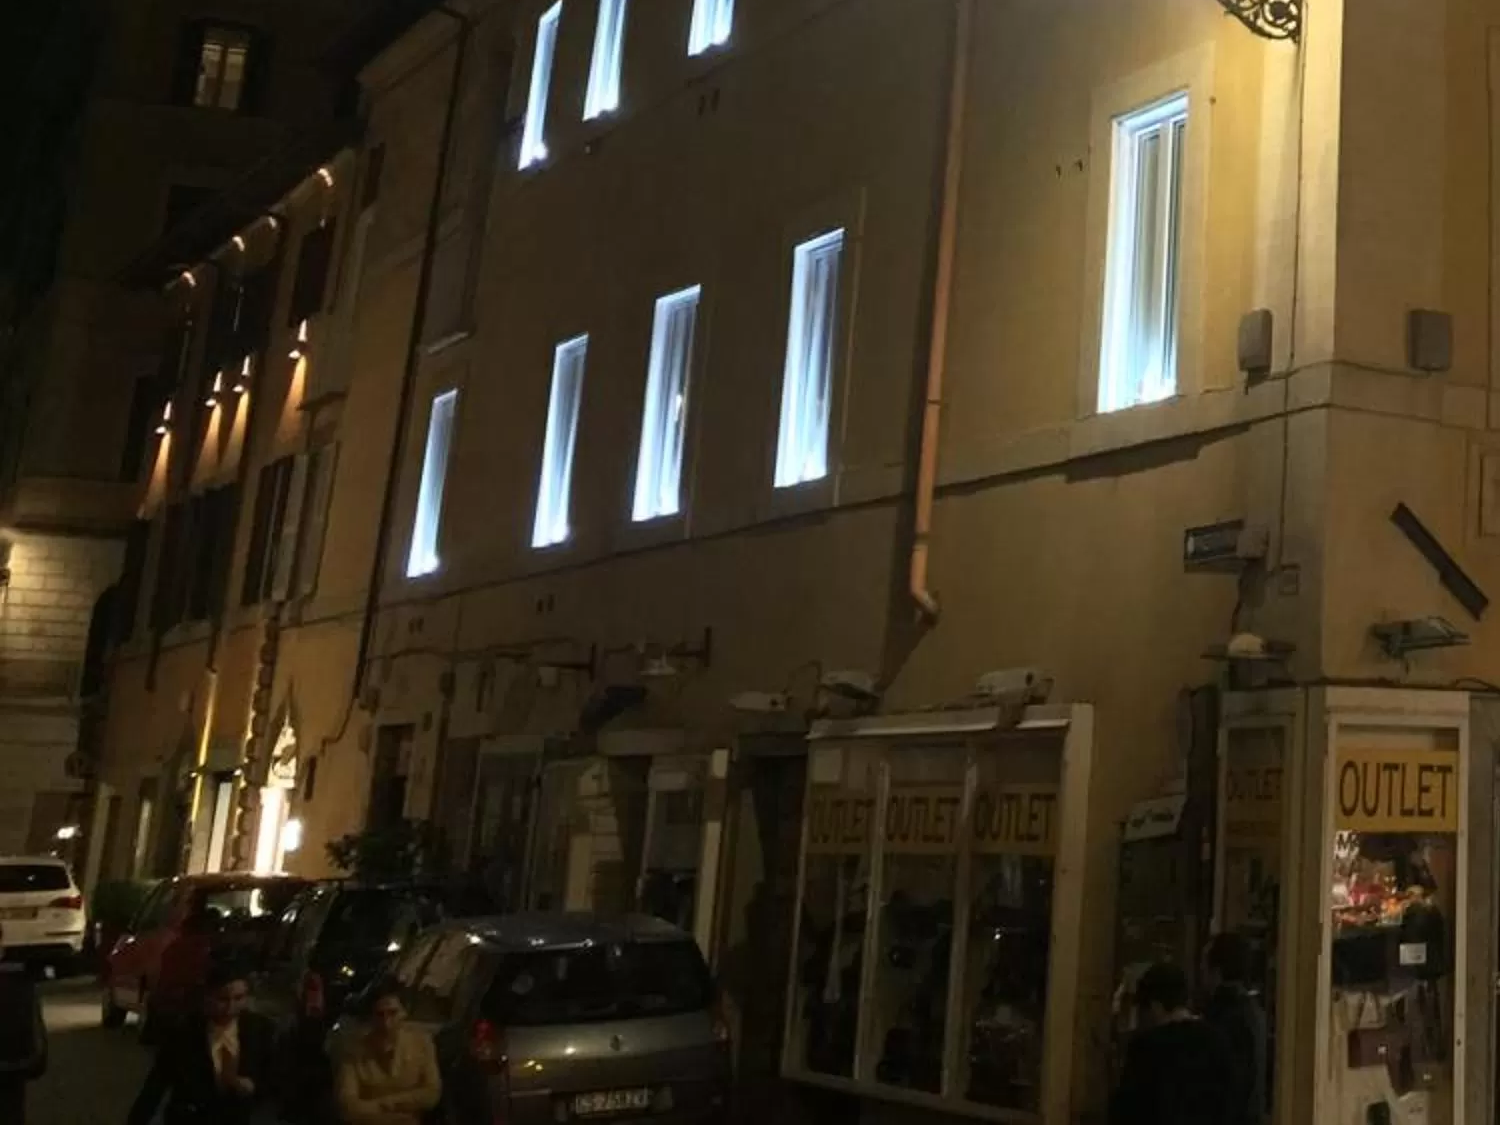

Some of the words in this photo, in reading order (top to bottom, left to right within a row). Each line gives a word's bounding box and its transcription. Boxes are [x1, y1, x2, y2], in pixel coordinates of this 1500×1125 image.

[1226, 766, 1285, 804] OUTLET
[1340, 760, 1453, 818] OUTLET
[811, 797, 876, 844] OUTLET
[887, 794, 960, 844] OUTLET
[974, 791, 1057, 844] OUTLET
